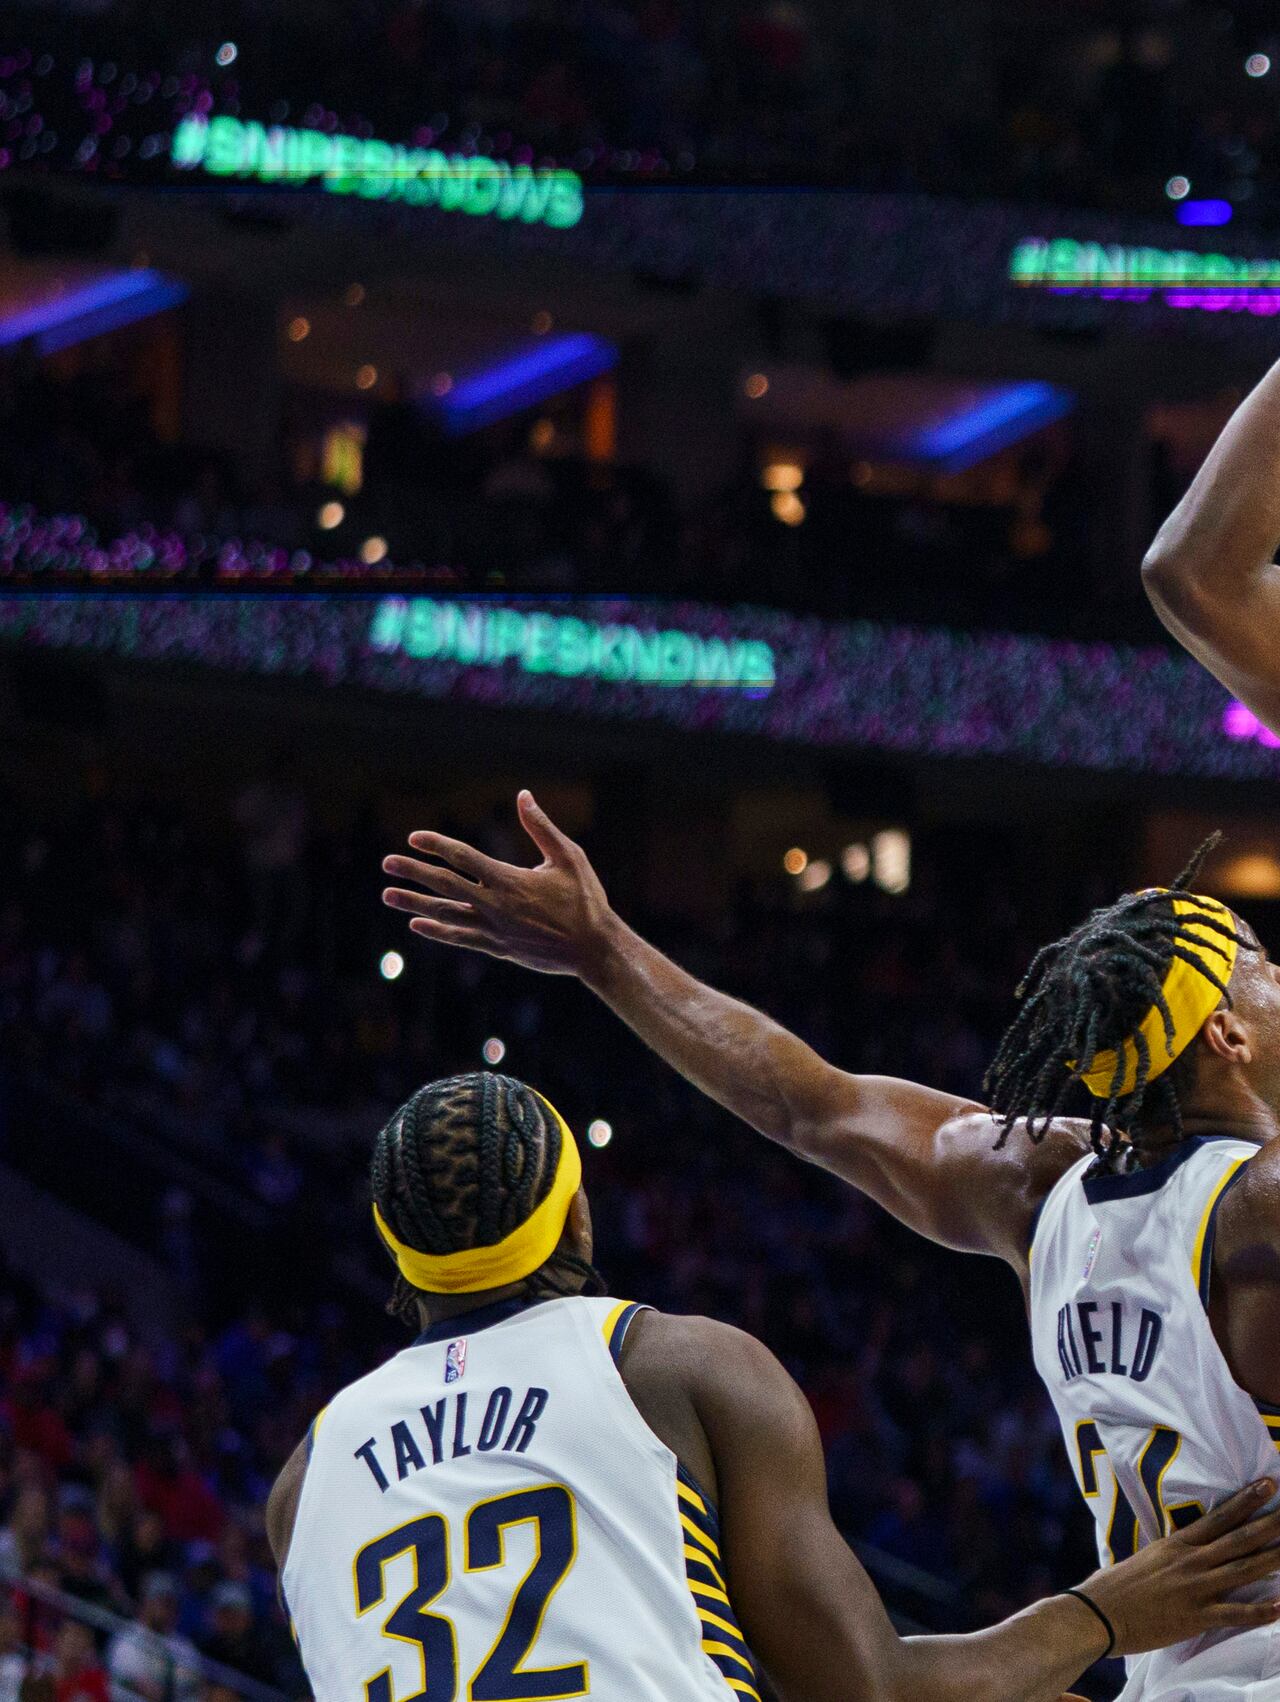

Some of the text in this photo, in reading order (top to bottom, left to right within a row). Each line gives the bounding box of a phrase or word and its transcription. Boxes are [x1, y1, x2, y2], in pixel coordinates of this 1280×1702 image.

[171, 115, 583, 228] #SNIPESKNOWS
[369, 597, 775, 697] #SNIPESKNOWS
[353, 1386, 549, 1494] TAYLOR
[352, 1483, 590, 1702] 32
